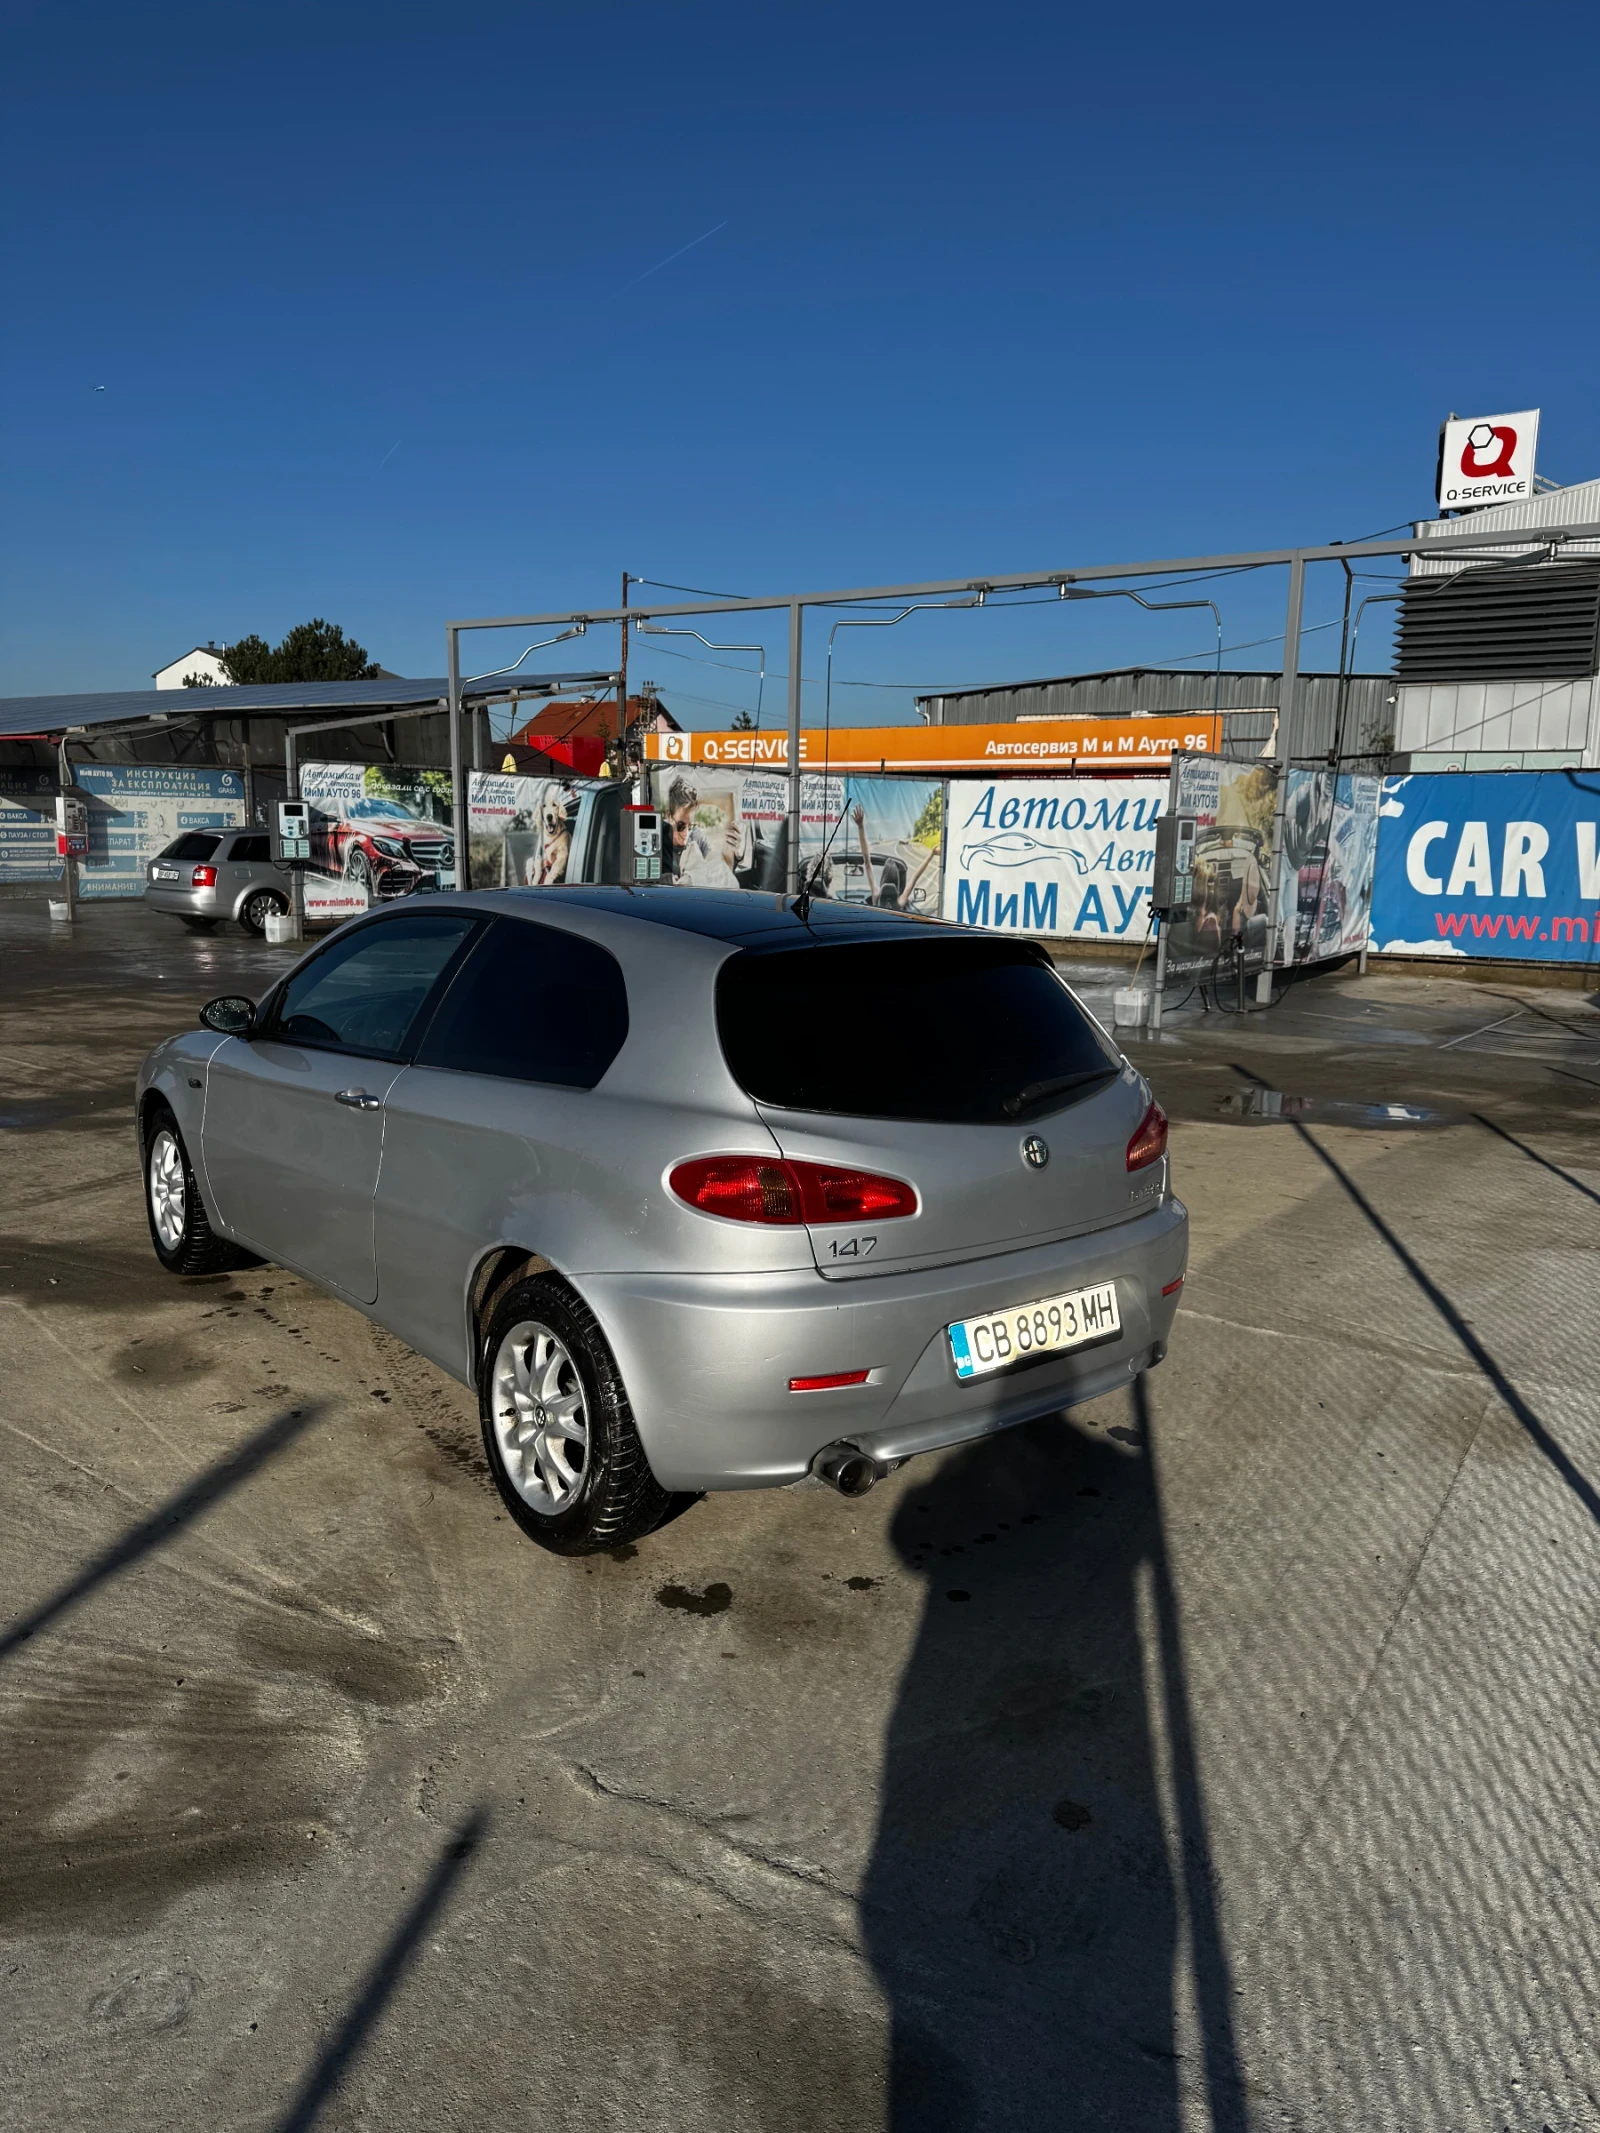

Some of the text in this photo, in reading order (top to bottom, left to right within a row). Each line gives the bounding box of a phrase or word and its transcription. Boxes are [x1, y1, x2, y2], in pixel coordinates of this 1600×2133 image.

[985, 734, 1208, 757] Автосервиз М и М Ауто 96
[126, 769, 196, 781] ИНСТРУКЦИЯ
[305, 769, 354, 780] Автомивка
[111, 779, 211, 791] ЗА ЕКСПЛОАТАЦИЯ
[371, 780, 412, 791] доказали
[304, 786, 361, 799] МиМ АУТО 96
[488, 796, 506, 805] АУТО
[507, 796, 516, 805] 96
[742, 798, 758, 809] МиМ
[801, 799, 816, 810] МиМ
[1193, 794, 1211, 808] АУТО
[961, 786, 1163, 832] Автоми
[7, 812, 28, 820] ВАКСА
[188, 816, 210, 825] ВАКСА
[8, 831, 28, 839] ПАУЗА
[32, 831, 49, 839] СТОП
[97, 837, 132, 846] ПРЕПАРАТ
[1406, 820, 1551, 898] CAR
[87, 882, 137, 891] ВНИМАНИЕ!
[308, 897, 365, 908] www.mim96.eu
[957, 878, 1059, 931] МиМ
[827, 1236, 878, 1258] 147
[1016, 1301, 1078, 1350] 8893
